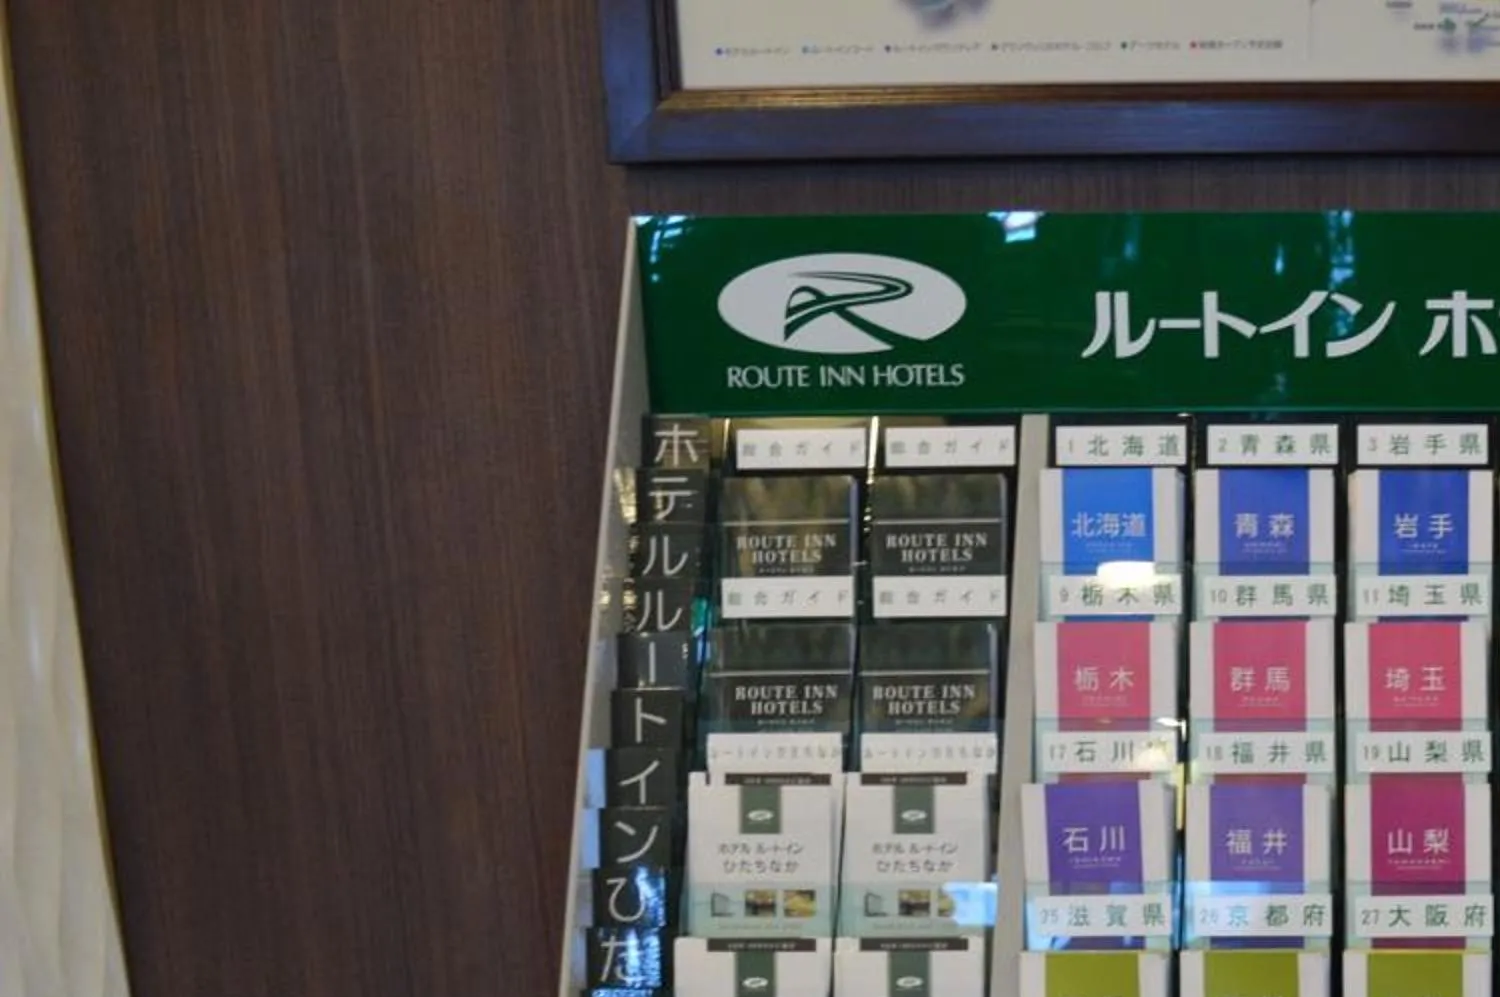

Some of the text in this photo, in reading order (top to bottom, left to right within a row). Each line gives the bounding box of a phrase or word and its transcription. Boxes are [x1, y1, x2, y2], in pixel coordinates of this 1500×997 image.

[1081, 290, 1396, 358] ルートイン
[726, 363, 966, 387] ROUTE INN HOTELS
[1087, 434, 1181, 456] 北海道
[1240, 433, 1332, 455] 青森県
[1389, 433, 1481, 455] 岩手県
[1072, 512, 1147, 538] 北海道
[1234, 513, 1295, 539] 青森
[1393, 513, 1454, 539] 岩手
[737, 534, 837, 549] ROUTE INN
[886, 534, 987, 548] ROUTE INN
[752, 549, 822, 562] HOTELS
[901, 548, 972, 562] HOTELS
[1236, 584, 1329, 606] 群馬県
[1389, 584, 1482, 606] 埼玉県
[1074, 666, 1134, 692] 栃木
[1230, 666, 1290, 693] 群馬
[1385, 666, 1446, 692] 埼玉
[735, 685, 838, 700] ROUTE INN
[872, 685, 975, 700] ROUTE INN
[751, 700, 823, 714] HOTELS
[888, 700, 961, 715] HOTELS
[1074, 740, 1168, 762] 石川
[1232, 740, 1325, 763] 福井県
[1390, 740, 1484, 762] 山梨県
[1062, 825, 1126, 853] 石川
[1226, 829, 1287, 855] 福井
[1387, 828, 1450, 855] 山梨
[722, 859, 799, 873] ひたちなか
[876, 859, 952, 873] ひたちなか
[1068, 902, 1165, 927] 滋賀県
[1227, 903, 1326, 927] 京都府
[1389, 903, 1487, 928] 大阪府
